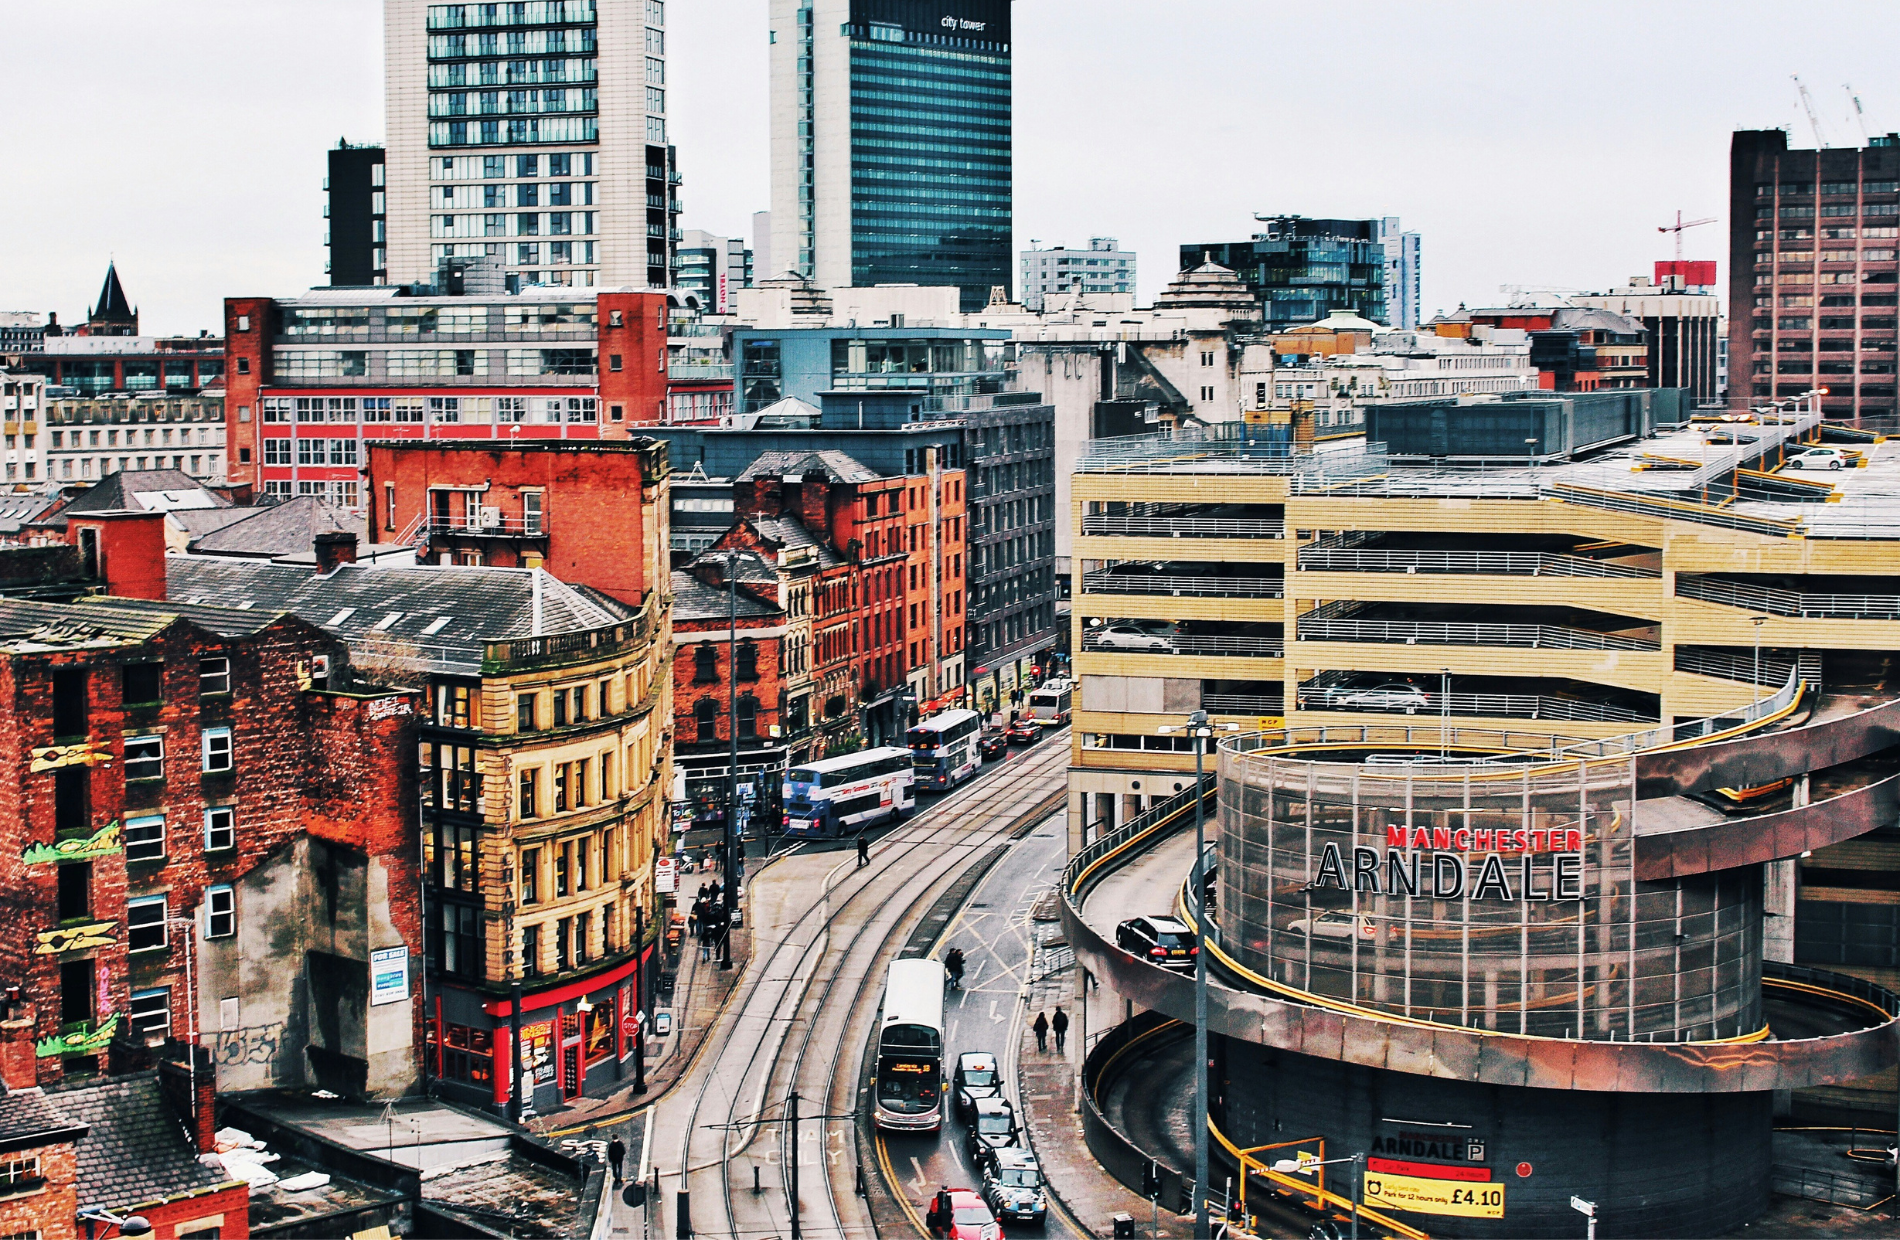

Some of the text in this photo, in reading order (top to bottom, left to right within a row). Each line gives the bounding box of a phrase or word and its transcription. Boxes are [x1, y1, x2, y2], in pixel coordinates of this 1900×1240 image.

[941, 15, 986, 31] city tower
[1386, 824, 1582, 852] MANCHESTER
[1314, 841, 1582, 902] ARNDALE
[502, 852, 515, 980] CHAMBERS
[373, 949, 405, 962] FOR SALE
[1371, 1136, 1463, 1161] ARNDALE
[1384, 1182, 1397, 1192] Early
[1384, 1190, 1396, 1198] Park
[1434, 1197, 1448, 1205] only
[1451, 1189, 1501, 1207] £4.10
